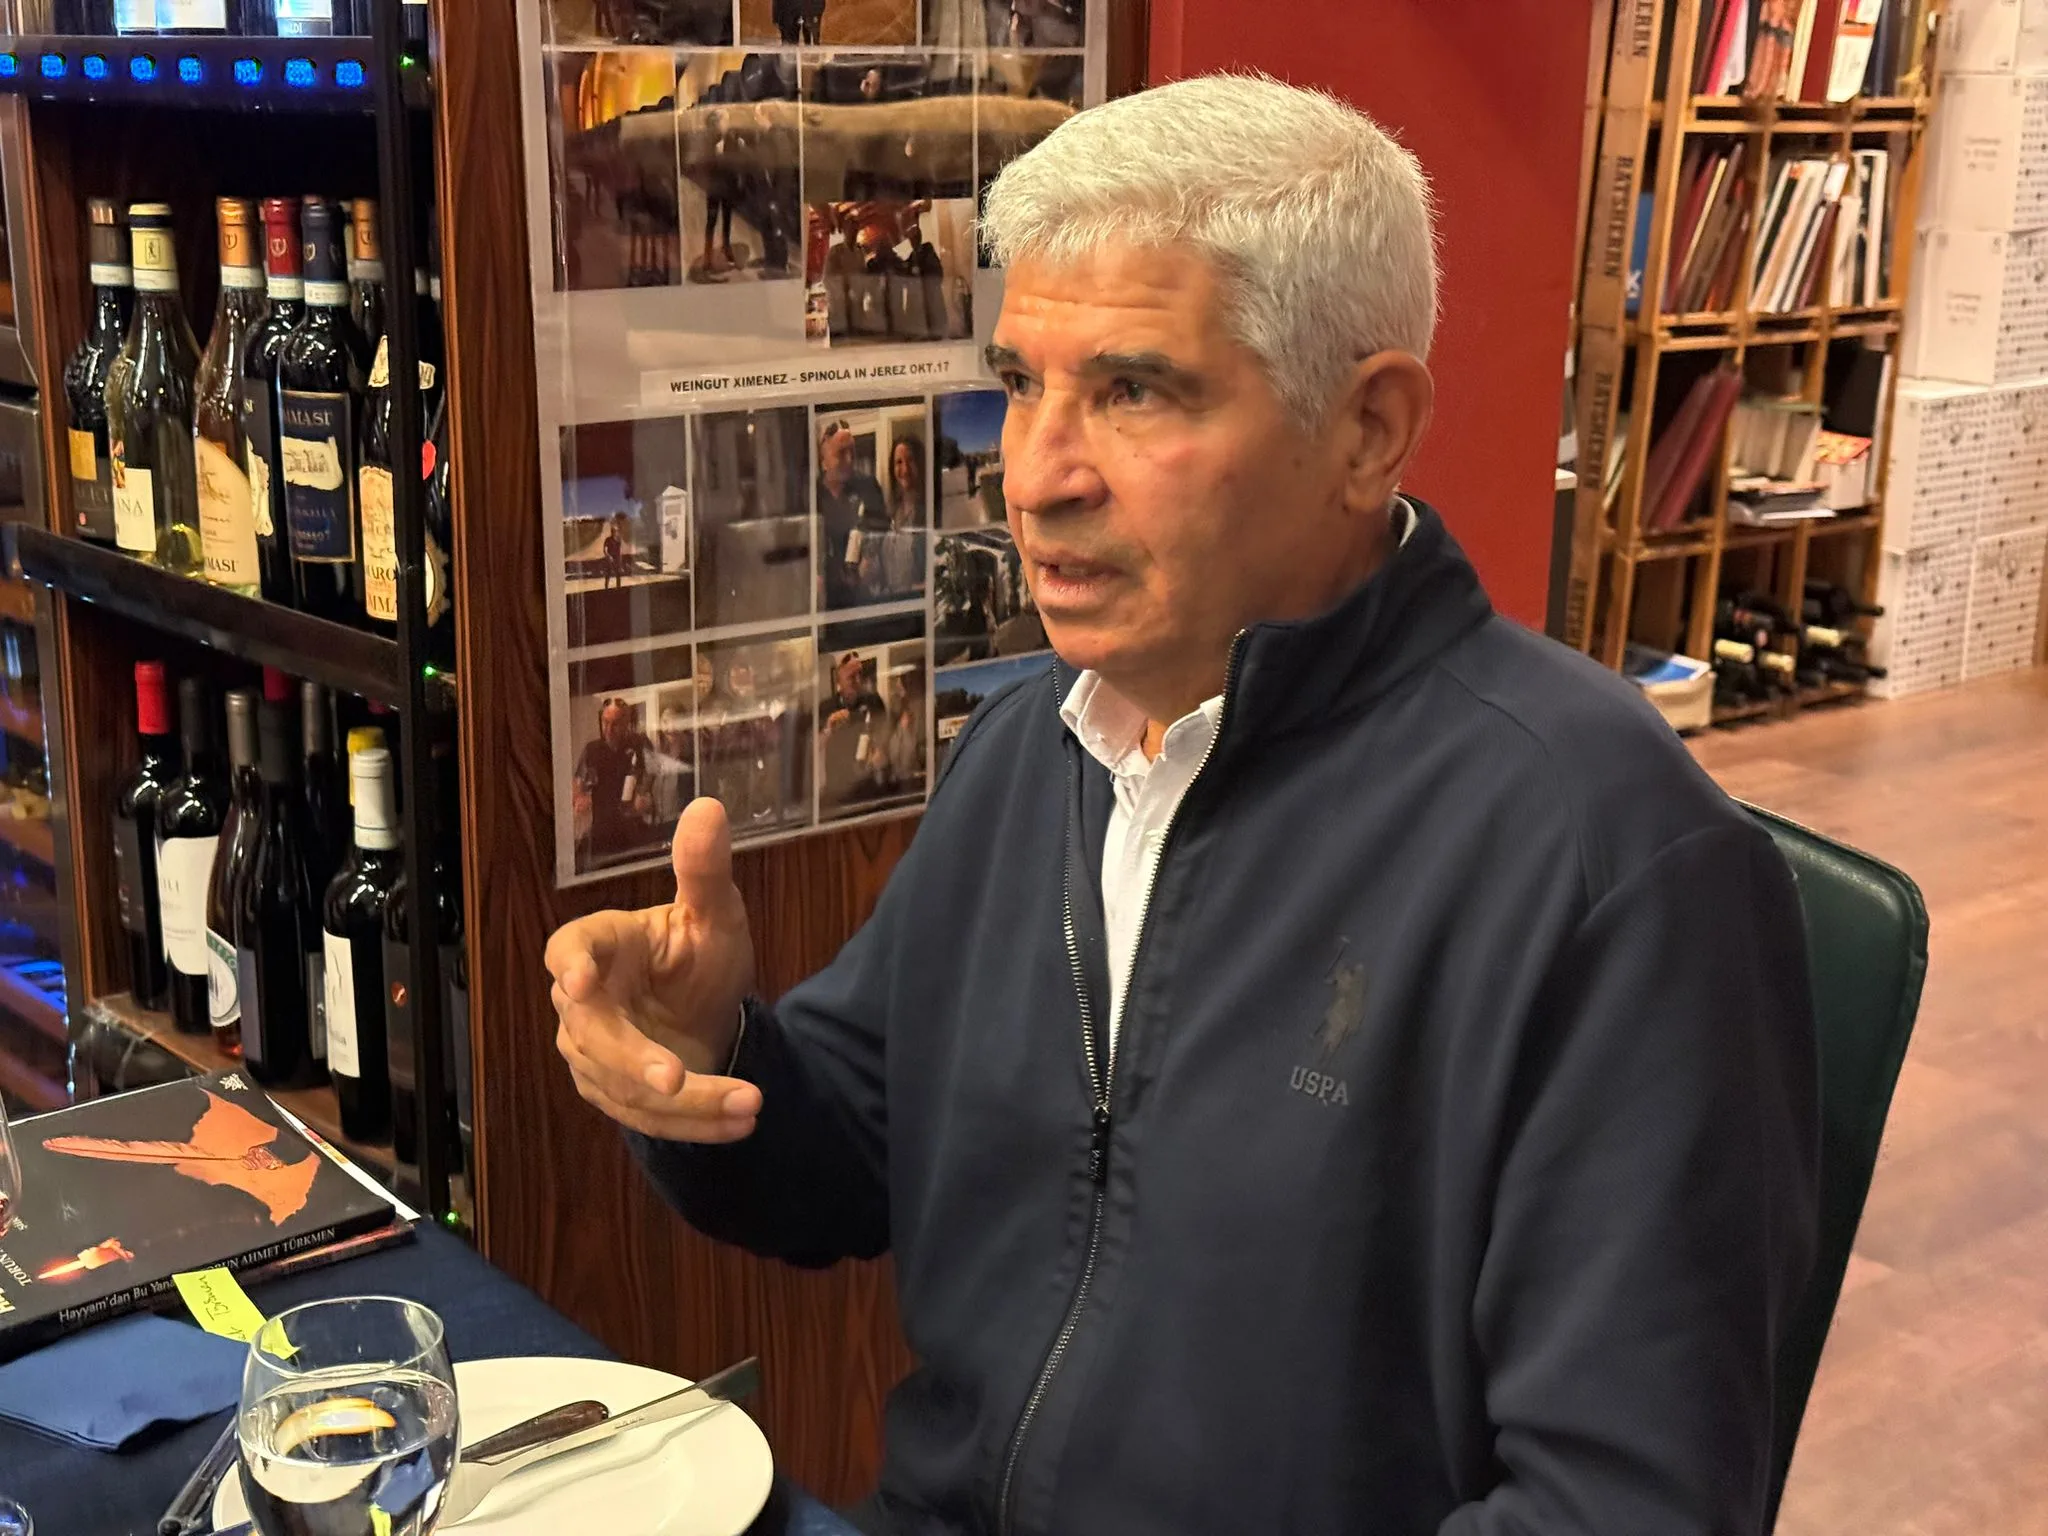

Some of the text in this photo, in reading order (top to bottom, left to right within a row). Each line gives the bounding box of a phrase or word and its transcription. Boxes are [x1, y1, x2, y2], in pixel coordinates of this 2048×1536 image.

[671, 378, 729, 392] WEINGUT
[733, 373, 788, 388] XIMENEZ
[800, 369, 851, 382] SPINOLA
[855, 367, 866, 378] IN
[870, 364, 907, 377] JEREZ
[909, 361, 949, 374] OKT.17
[1290, 1066, 1349, 1105] USPA
[241, 1245, 281, 1266] AHMET
[283, 1227, 336, 1251] TÜRKMEN
[60, 1293, 131, 1321] Hayyam'dan
[133, 1287, 148, 1299] Bu
